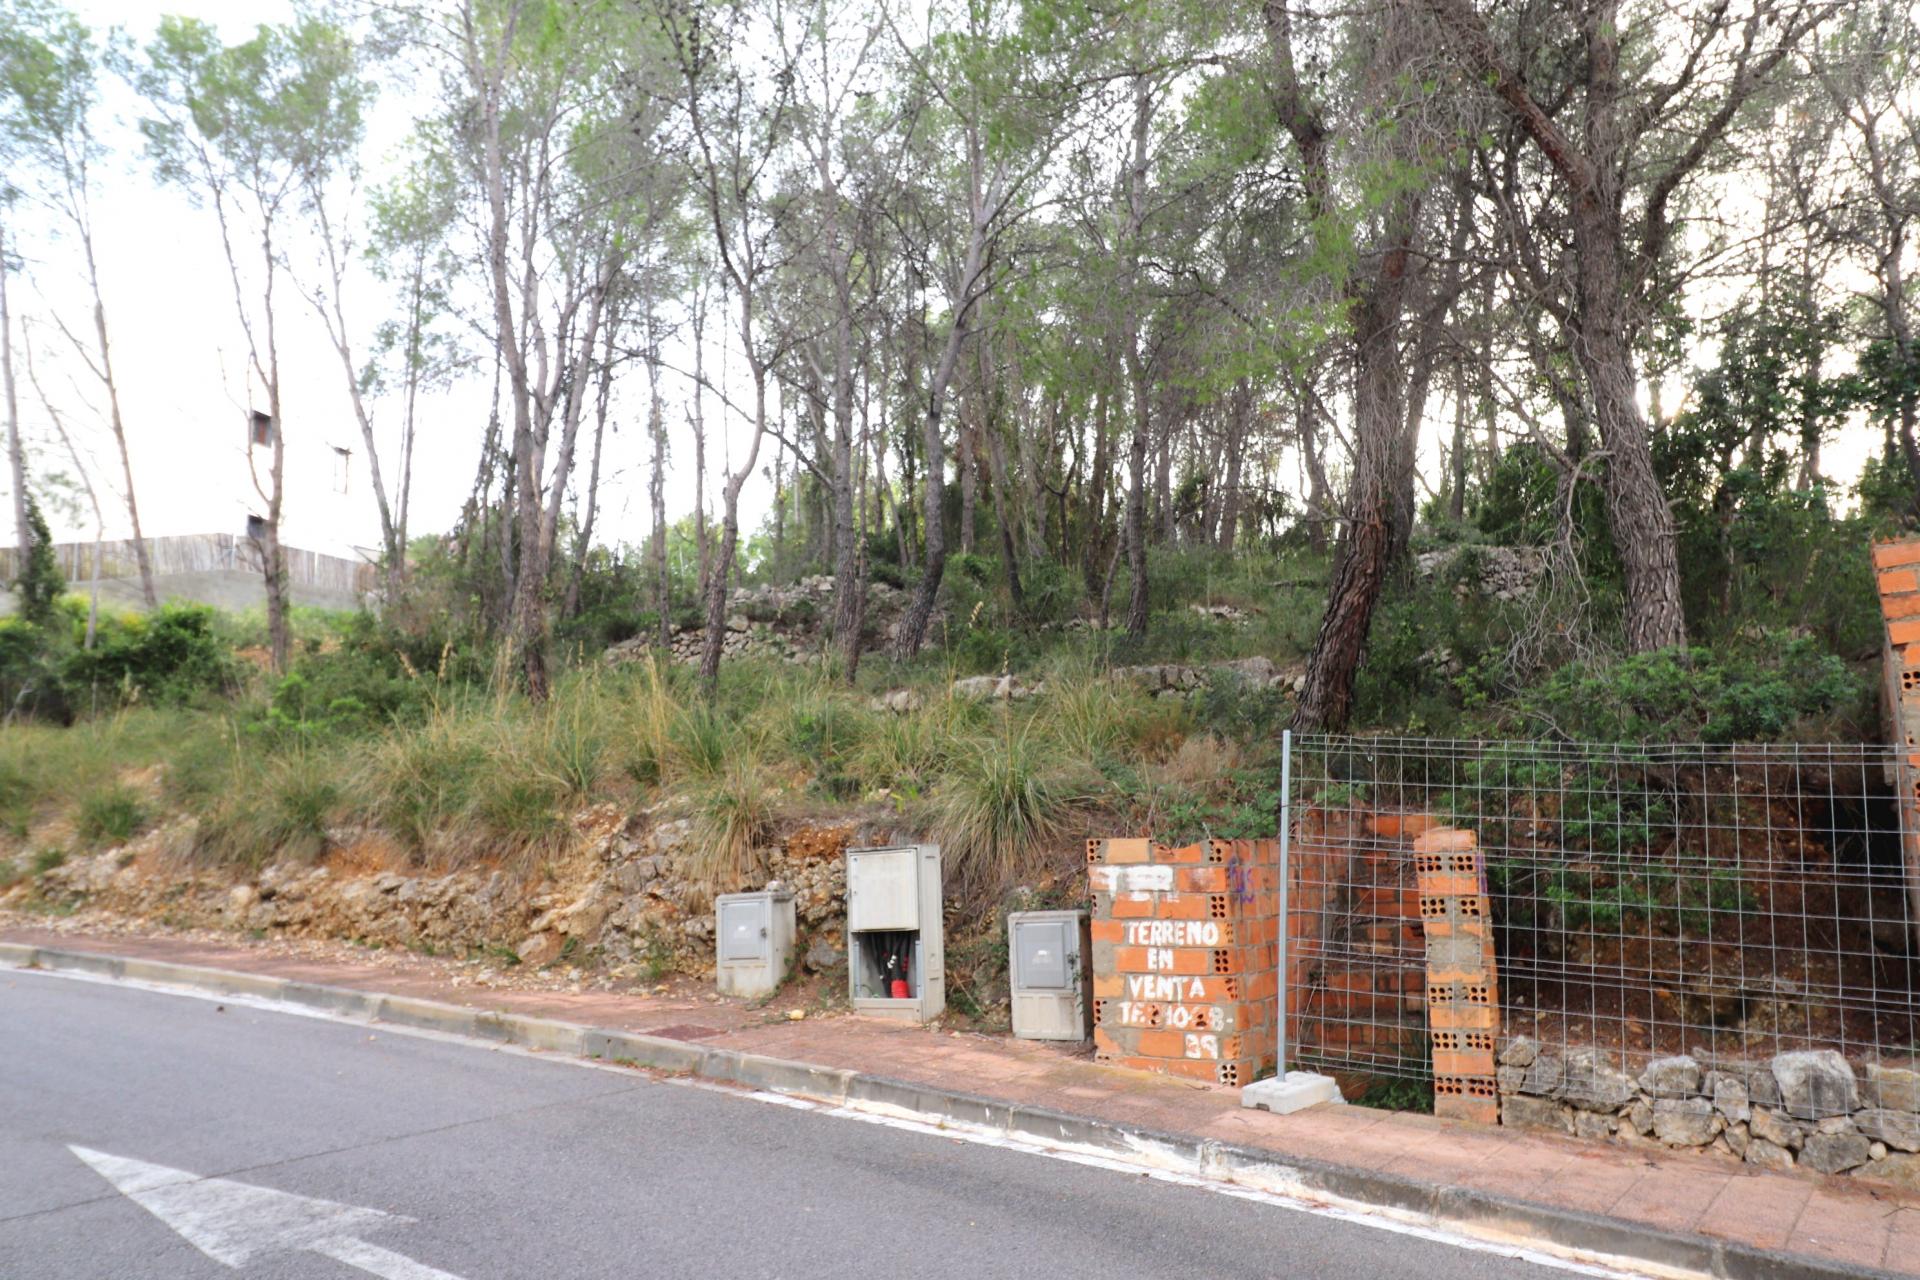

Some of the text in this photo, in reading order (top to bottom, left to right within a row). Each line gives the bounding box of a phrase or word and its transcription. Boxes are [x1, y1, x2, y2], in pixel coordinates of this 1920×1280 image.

[1128, 921, 1219, 946] TERRENO
[1147, 948, 1174, 970] EN
[1128, 975, 1206, 1001] VENTA
